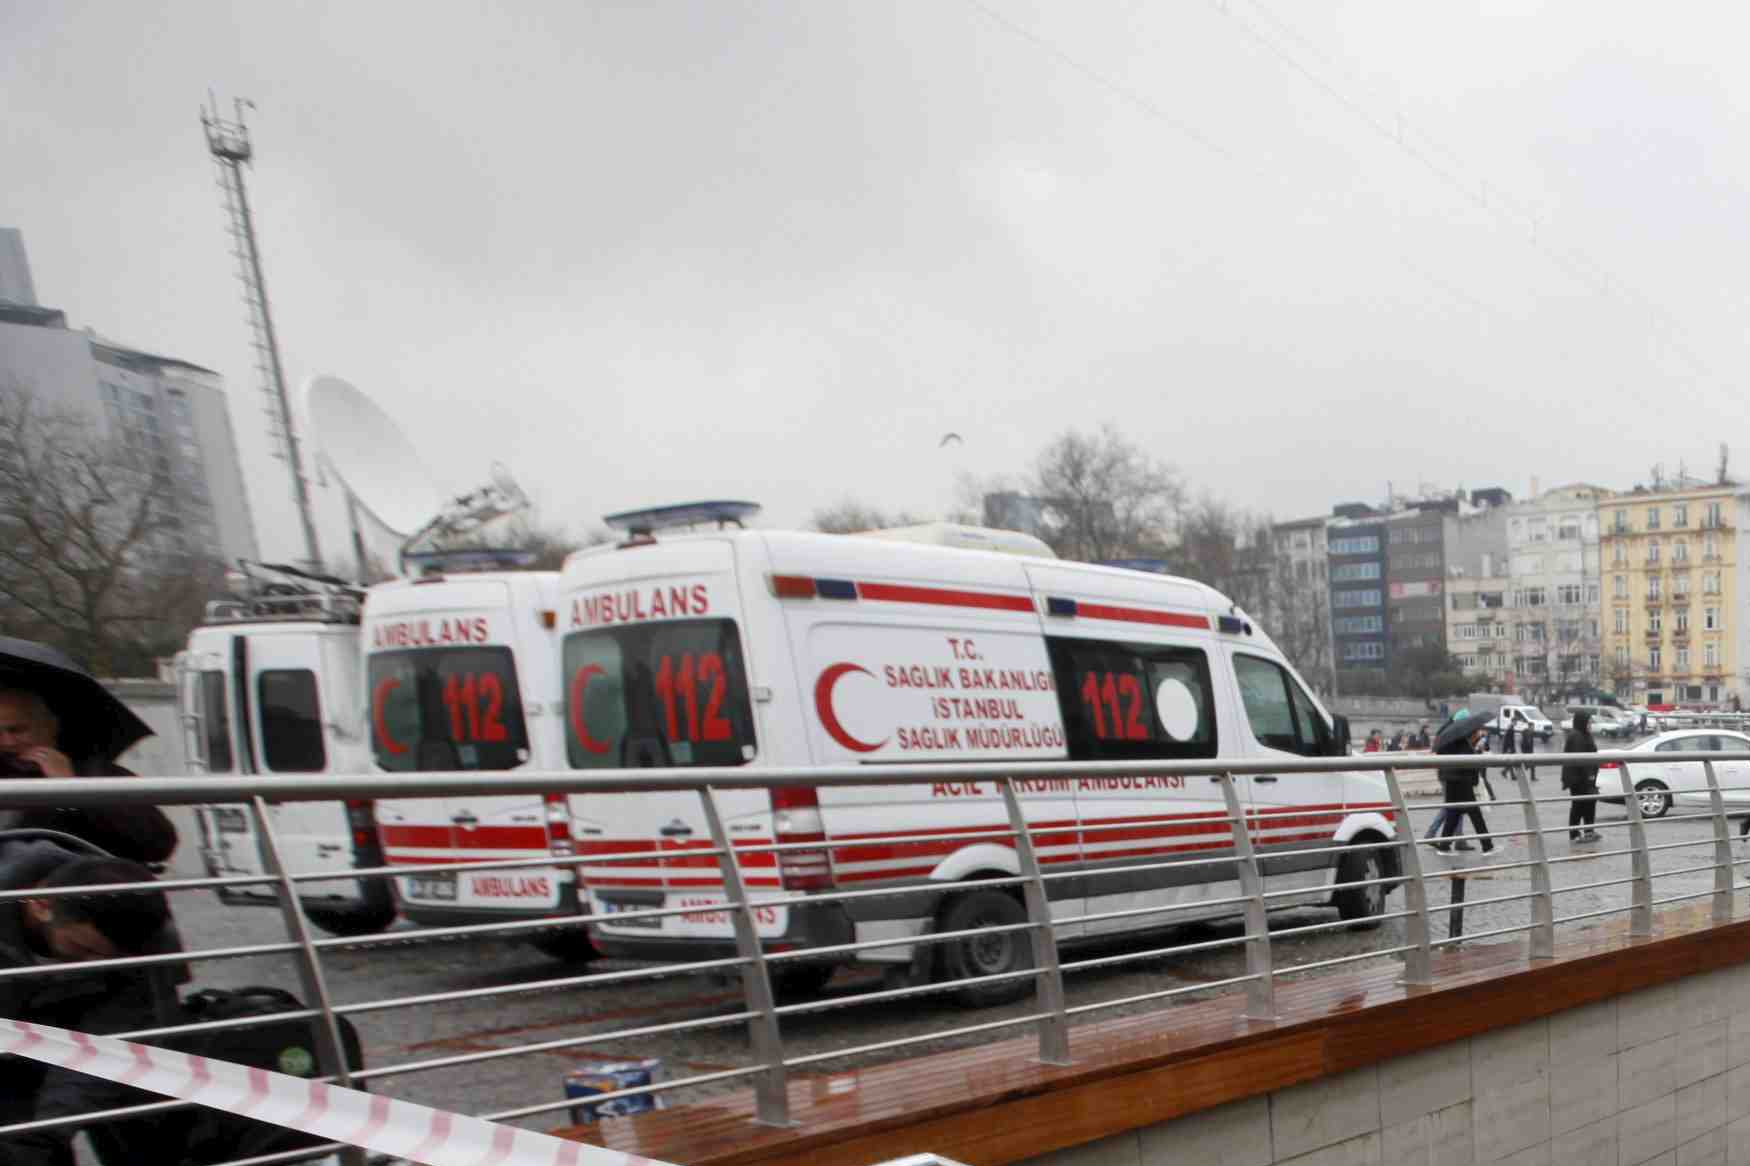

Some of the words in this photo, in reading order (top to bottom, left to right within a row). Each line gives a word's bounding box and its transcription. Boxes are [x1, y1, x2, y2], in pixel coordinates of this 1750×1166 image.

[570, 584, 710, 628] AMBULANS
[373, 618, 489, 647] AMBULANS
[946, 636, 984, 661] T.C.
[441, 672, 509, 742] 112
[655, 650, 733, 742] 112
[1081, 671, 1150, 740] 112
[472, 876, 550, 897] AMBULANS
